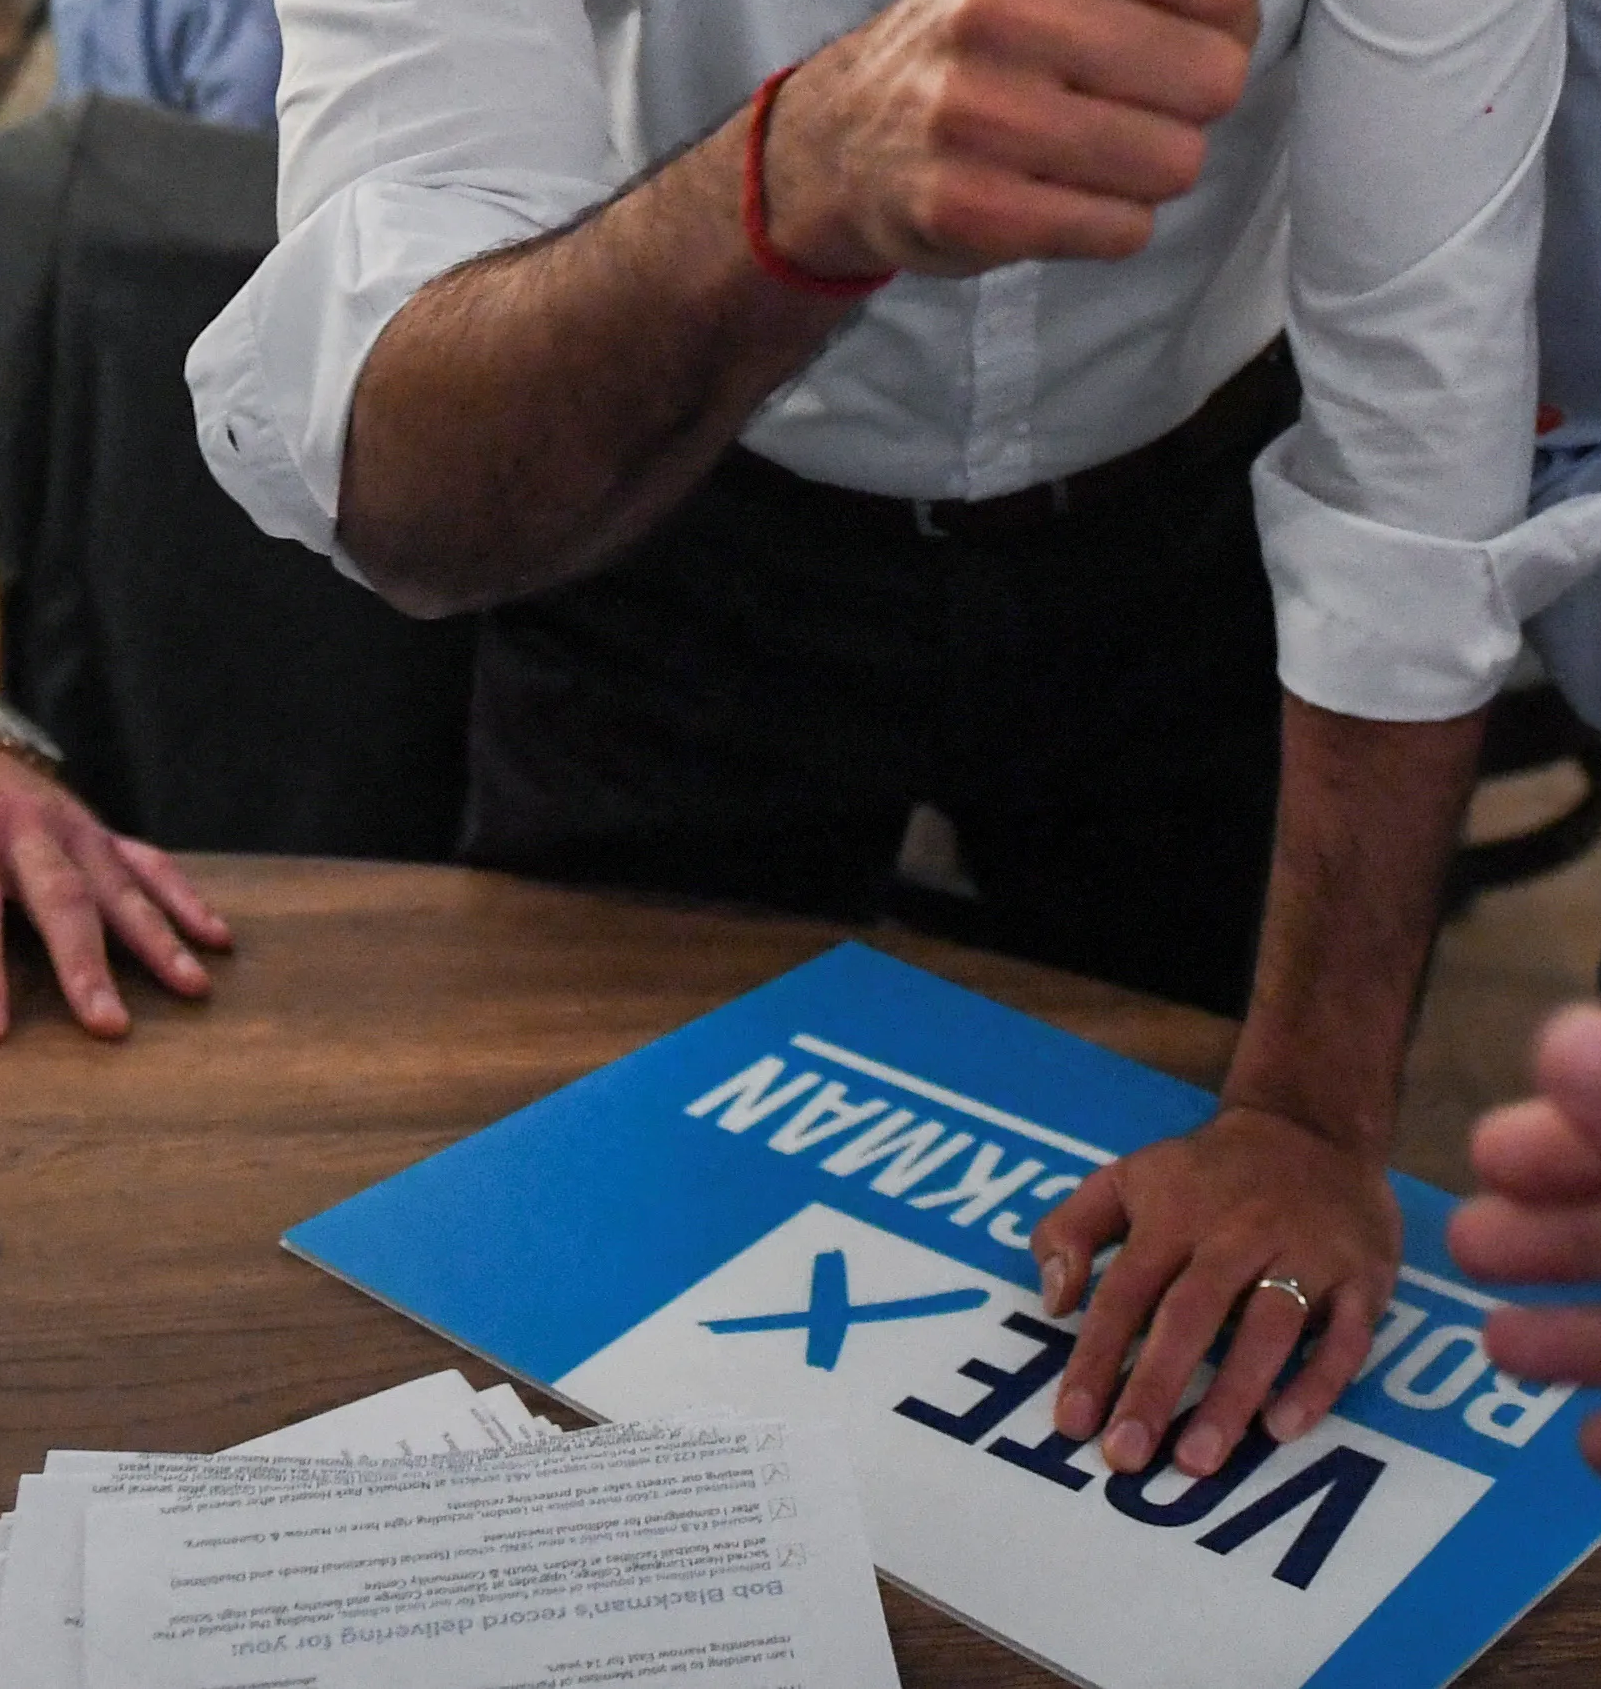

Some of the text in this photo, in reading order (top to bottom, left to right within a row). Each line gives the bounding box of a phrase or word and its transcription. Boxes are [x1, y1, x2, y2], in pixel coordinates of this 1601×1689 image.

[698, 1445, 749, 1460] Secured
[534, 1460, 587, 1477] upgrade
[606, 1455, 651, 1469] million
[334, 1486, 363, 1498] Park
[366, 1479, 430, 1495] Northwick
[446, 1466, 754, 1511] keeping our streets safer and protecting residents
[663, 1486, 692, 1496] over
[694, 1479, 756, 1494] Recruited
[245, 1495, 276, 1508] after
[277, 1487, 332, 1504] Hospital
[587, 1494, 622, 1504] more
[196, 1499, 242, 1513] several
[475, 1502, 528, 1519] London,
[546, 1496, 585, 1511] police
[730, 1502, 761, 1515] after
[382, 1515, 413, 1529] right
[415, 1508, 474, 1525] including
[622, 1516, 641, 1527] for
[642, 1505, 721, 1525] campaigned
[710, 1514, 763, 1529] Secured
[283, 1525, 332, 1540] Harrow
[349, 1520, 380, 1532] here
[556, 1518, 620, 1535] additional
[632, 1524, 678, 1538] million
[536, 1536, 566, 1547] new
[579, 1531, 613, 1544] build
[712, 1540, 739, 1550] new
[742, 1537, 766, 1549] and
[453, 1544, 495, 1558] school
[604, 1549, 658, 1564] facilities
[660, 1543, 710, 1558] football
[725, 1548, 770, 1562] Sacred
[320, 1555, 397, 1573] Educational
[623, 1556, 685, 1574] Language
[688, 1554, 723, 1567] Heart
[248, 1568, 274, 1581] and
[277, 1563, 319, 1577] Needs
[409, 1567, 485, 1586] Community
[501, 1563, 538, 1576] Youth
[569, 1564, 621, 1580] College,
[655, 1568, 706, 1584] millions
[708, 1561, 771, 1578] Delivered
[506, 1570, 567, 1587] upgrades
[585, 1574, 635, 1592] pounds
[373, 1586, 422, 1602] College
[424, 1581, 488, 1597] Stanmore
[477, 1587, 529, 1604] funding
[345, 1594, 371, 1606] and
[453, 1595, 475, 1607] for
[167, 1612, 214, 1626] School
[215, 1606, 247, 1620] High
[230, 1580, 784, 1656] Bob Blackman's record delivering for you:
[274, 1609, 335, 1627] including
[197, 1621, 245, 1636] rebuild
[708, 1634, 791, 1653] representing
[627, 1651, 655, 1664] East
[656, 1645, 706, 1660] Harrow
[706, 1651, 763, 1669] standing
[605, 1655, 625, 1666] for
[636, 1663, 667, 1676] your
[576, 1669, 634, 1686] Member
